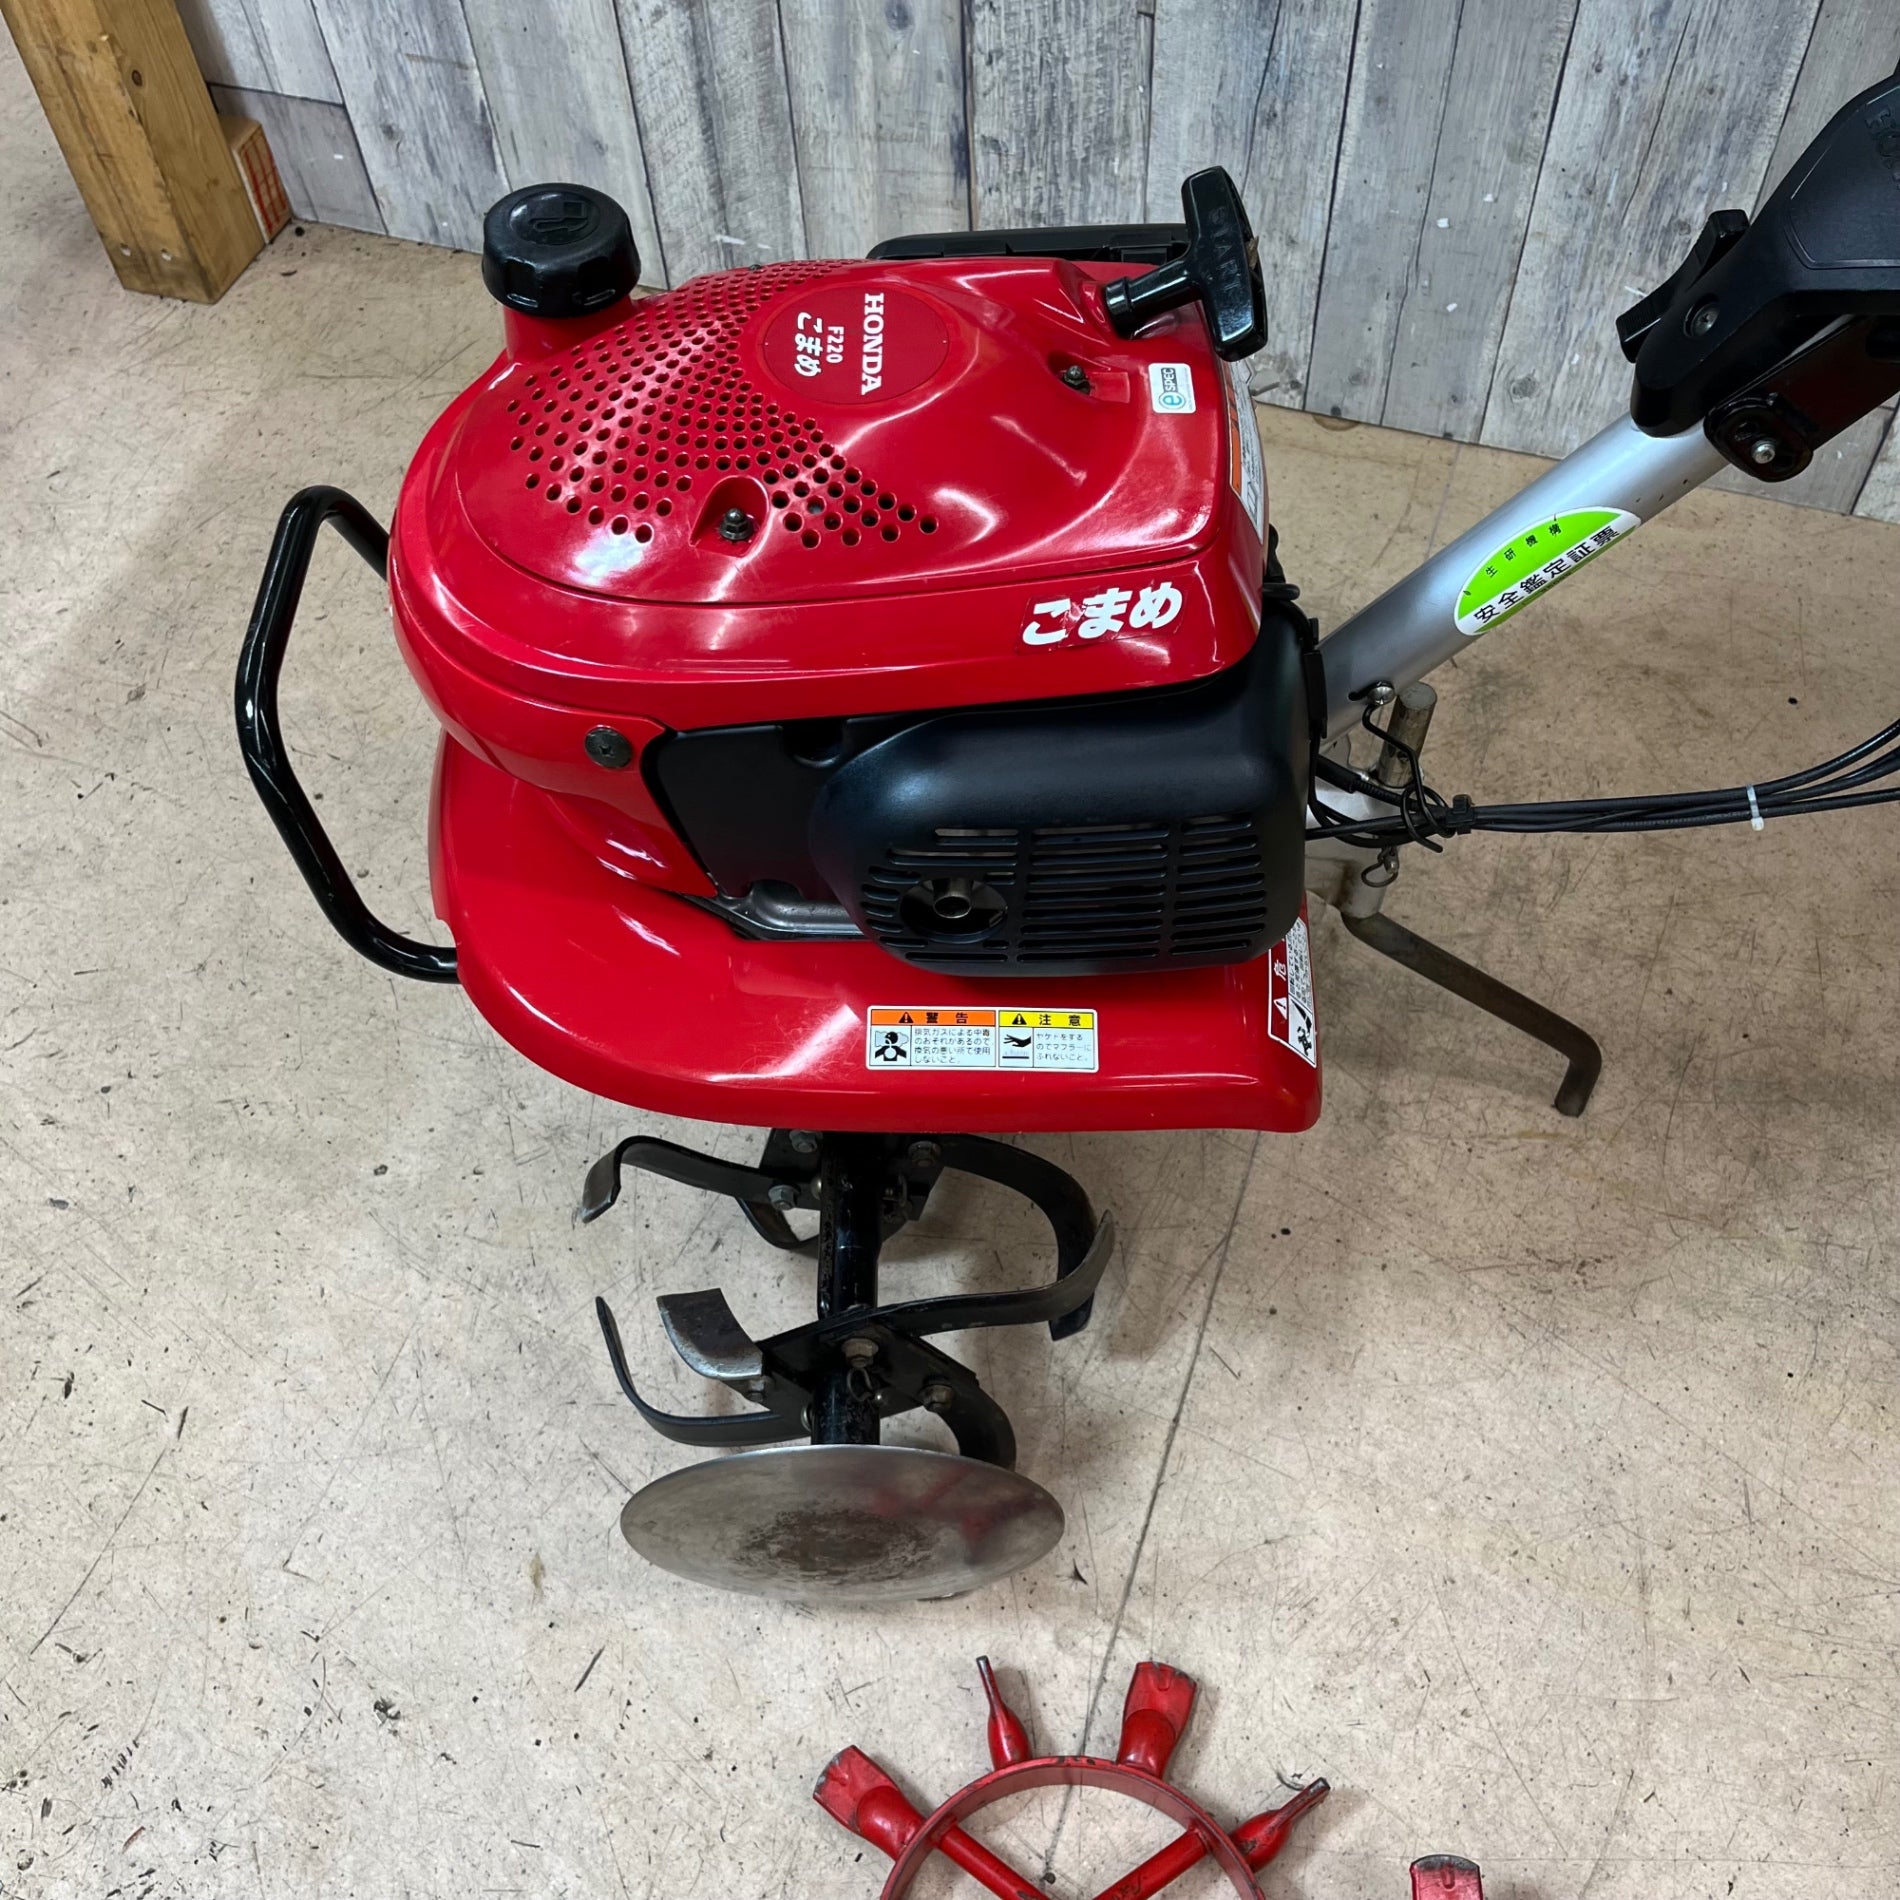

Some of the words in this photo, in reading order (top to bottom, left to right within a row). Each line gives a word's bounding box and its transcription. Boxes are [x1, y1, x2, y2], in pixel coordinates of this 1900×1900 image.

[794, 311, 823, 377] こまめ
[826, 325, 845, 364] F220
[861, 292, 885, 396] HONDA
[1163, 367, 1177, 392] SPEC
[1022, 581, 1183, 646] こまめ
[1273, 959, 1287, 982] 危
[926, 1012, 969, 1024] 警告
[1038, 1013, 1082, 1027] 注意
